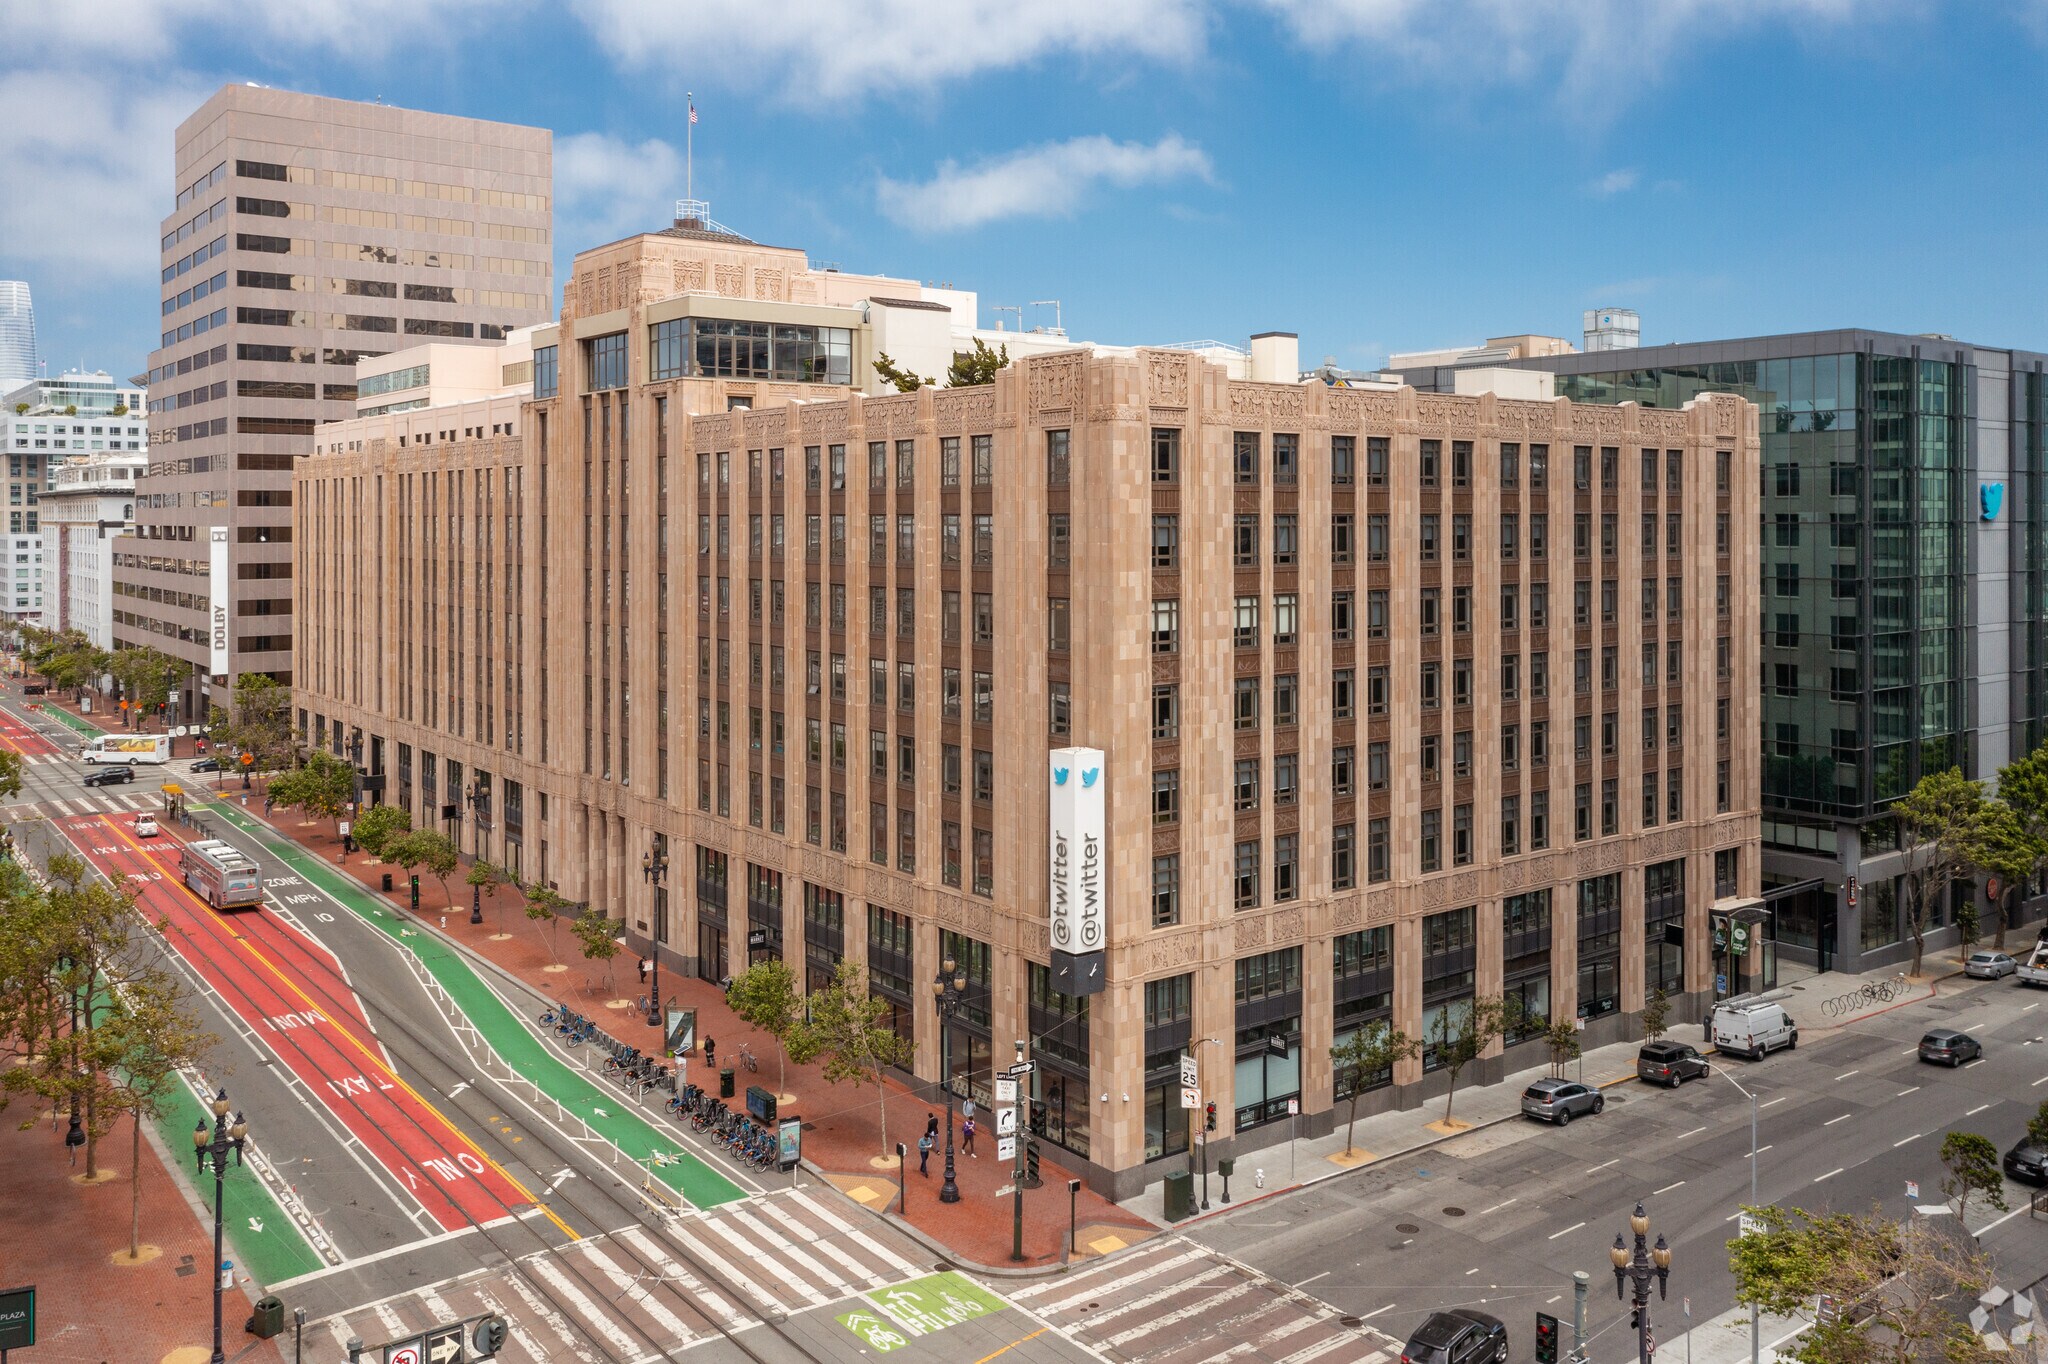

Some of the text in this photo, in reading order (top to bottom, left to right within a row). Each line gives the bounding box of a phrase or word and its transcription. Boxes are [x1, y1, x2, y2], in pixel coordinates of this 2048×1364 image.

[214, 605, 225, 650] DOLBY
[92, 844, 133, 856] TAXI
[263, 876, 303, 888] ZONE
[1053, 830, 1071, 946] @twitter
[1081, 833, 1101, 947] @twitter
[286, 892, 323, 905] MPH
[313, 912, 335, 923] 10
[262, 1010, 328, 1032] MUNI
[1182, 1057, 1196, 1067] SPEED
[1183, 1065, 1195, 1073] LIMIT
[326, 1073, 394, 1098] TAXI
[1182, 1072, 1197, 1086] 25
[401, 1153, 485, 1190] ONLY
[884, 1299, 923, 1319] TO
[0, 1311, 26, 1321] PLAZA
[432, 1349, 443, 1357] ONE
